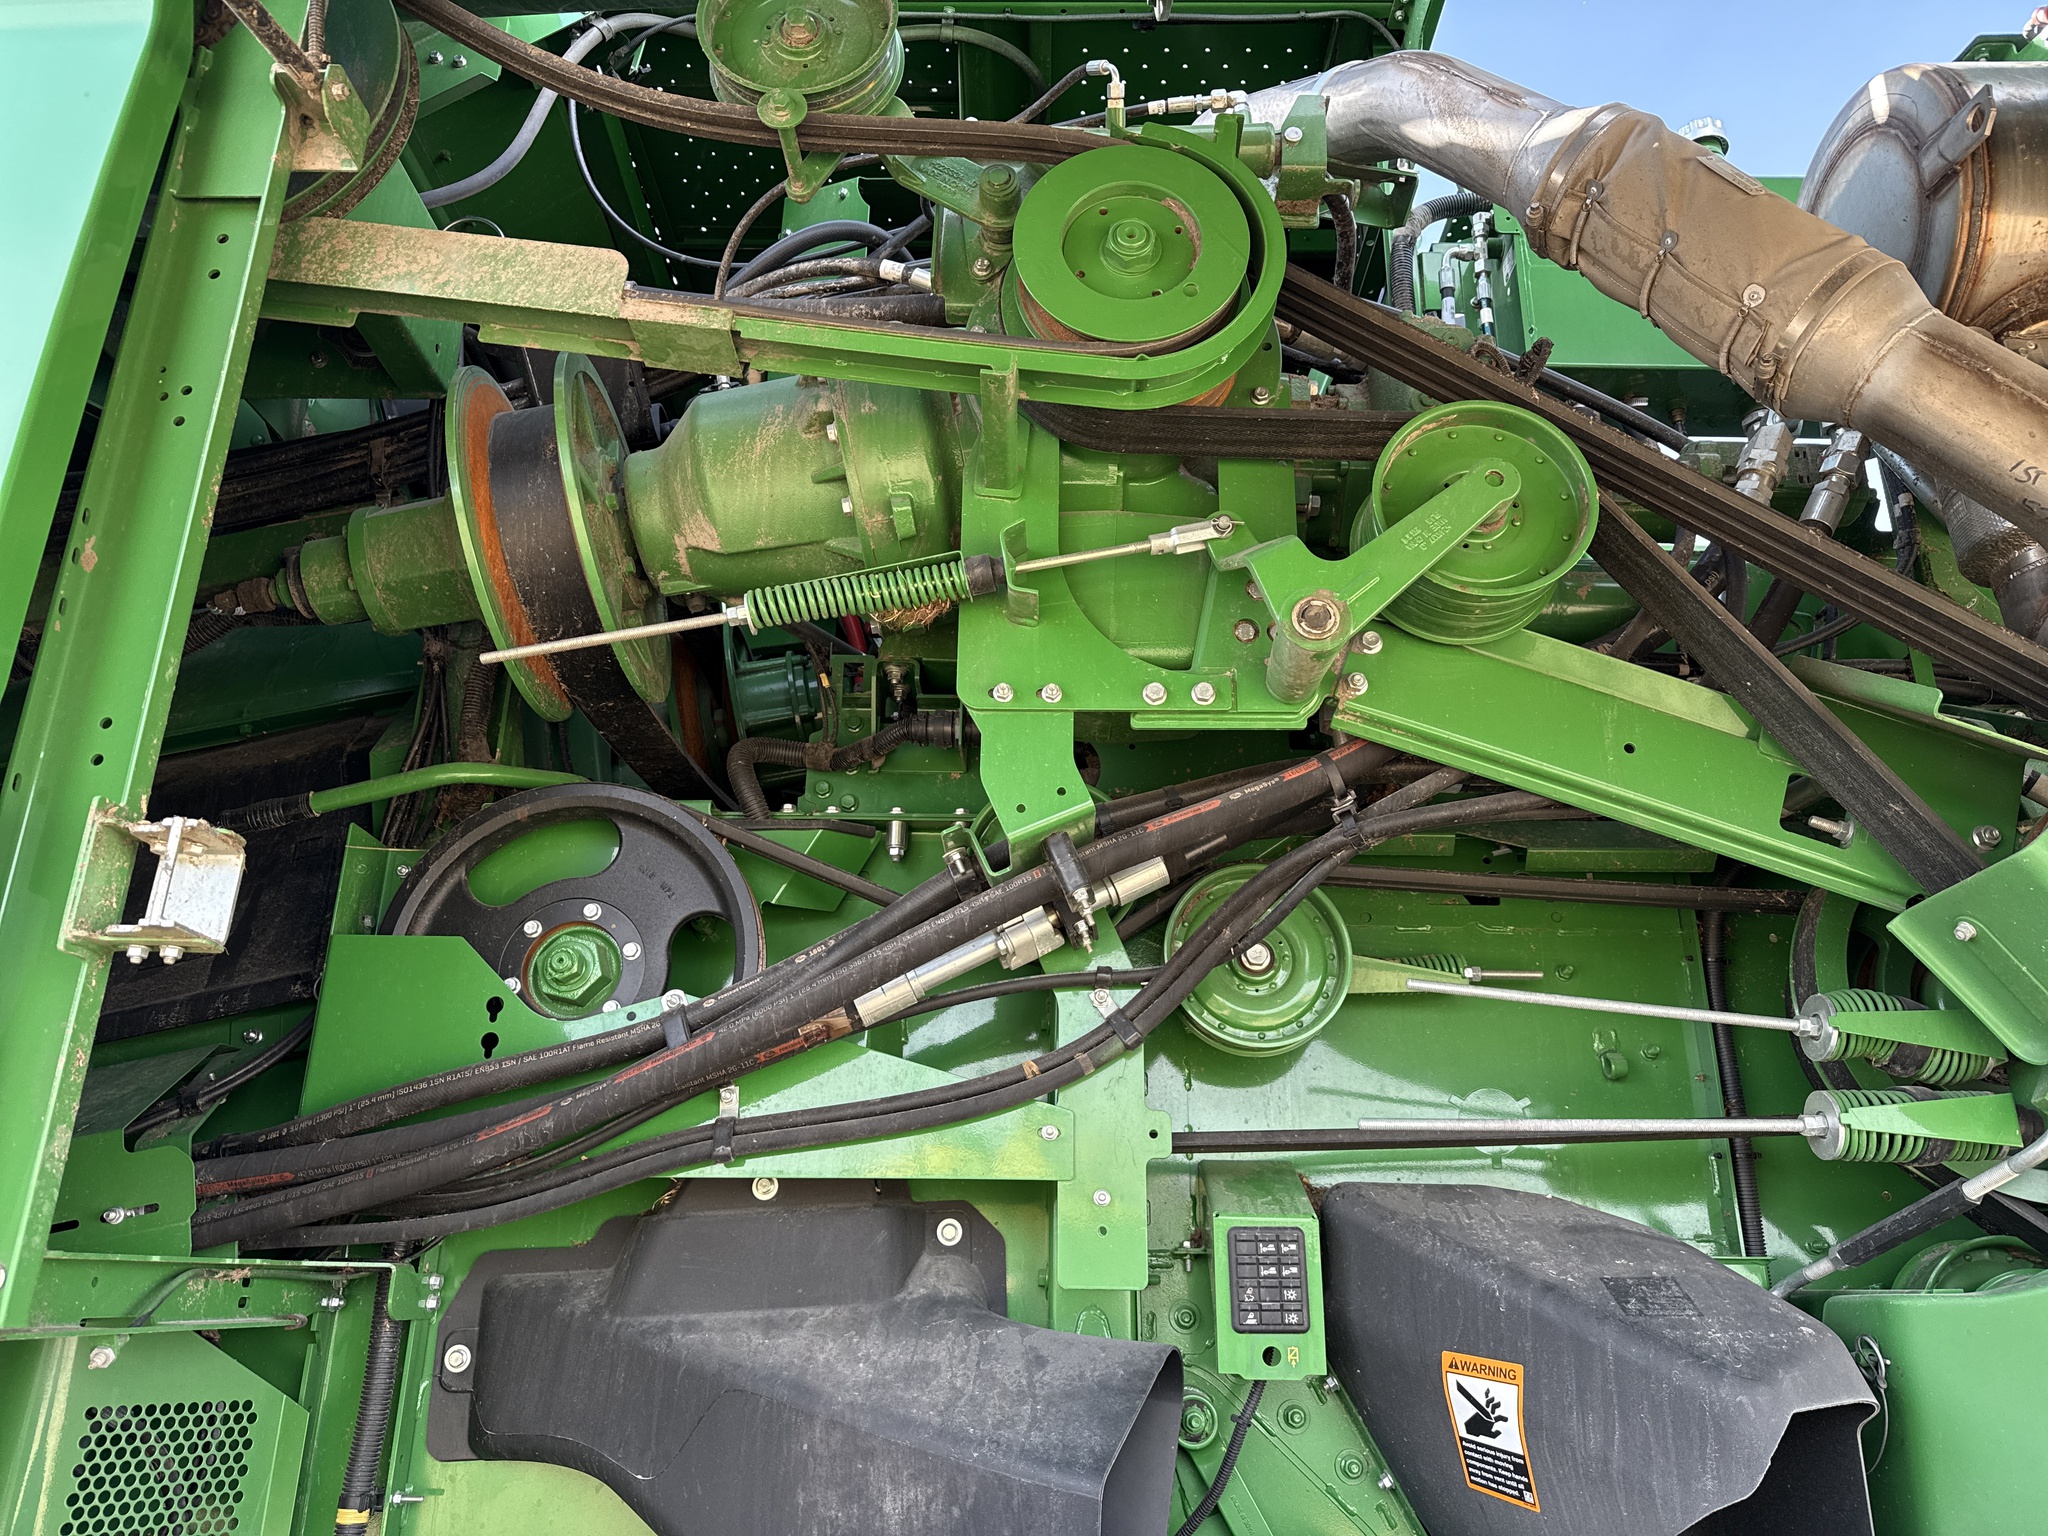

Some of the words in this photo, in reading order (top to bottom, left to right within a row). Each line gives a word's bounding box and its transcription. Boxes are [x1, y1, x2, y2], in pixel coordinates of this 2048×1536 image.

[1097, 838, 1118, 850] MSHA
[1118, 827, 1145, 842] 2G-11C
[735, 1015, 751, 1027] MPa
[867, 949, 882, 960] R15
[902, 924, 931, 942] Exceeds
[931, 912, 954, 927] EN856
[955, 904, 969, 916] R15
[1005, 875, 1032, 892] 100R15
[396, 1081, 428, 1096] ISO1436
[475, 1062, 500, 1075] EN853
[523, 1054, 538, 1063] SAE
[539, 1046, 571, 1059] 100R1AT
[572, 1041, 595, 1051] Flame
[596, 1030, 629, 1044] Resistant
[630, 1023, 651, 1036] MSHA
[706, 1069, 727, 1081] MSHA
[728, 1059, 755, 1074] 2G-11C
[233, 1201, 262, 1215] Exceeds
[375, 1164, 396, 1174] Flame
[396, 1152, 428, 1168] Resistant
[1460, 1360, 1517, 1381] WARNING
[1462, 1441, 1476, 1450] Avoid
[1477, 1445, 1495, 1456] serious
[1496, 1450, 1511, 1462] injury
[1511, 1455, 1524, 1464] from
[1464, 1450, 1483, 1461] contact
[1483, 1455, 1494, 1464] with
[1494, 1459, 1514, 1471] moving
[1466, 1459, 1497, 1472] components.
[1498, 1468, 1511, 1478] Keep
[1512, 1472, 1528, 1482] hands
[1469, 1467, 1481, 1476] away
[1481, 1470, 1494, 1479] from
[1494, 1474, 1505, 1483] vent
[1506, 1478, 1518, 1488] until
[1471, 1475, 1488, 1487] motion
[1488, 1480, 1497, 1489] has
[1498, 1484, 1520, 1497] stopped.
